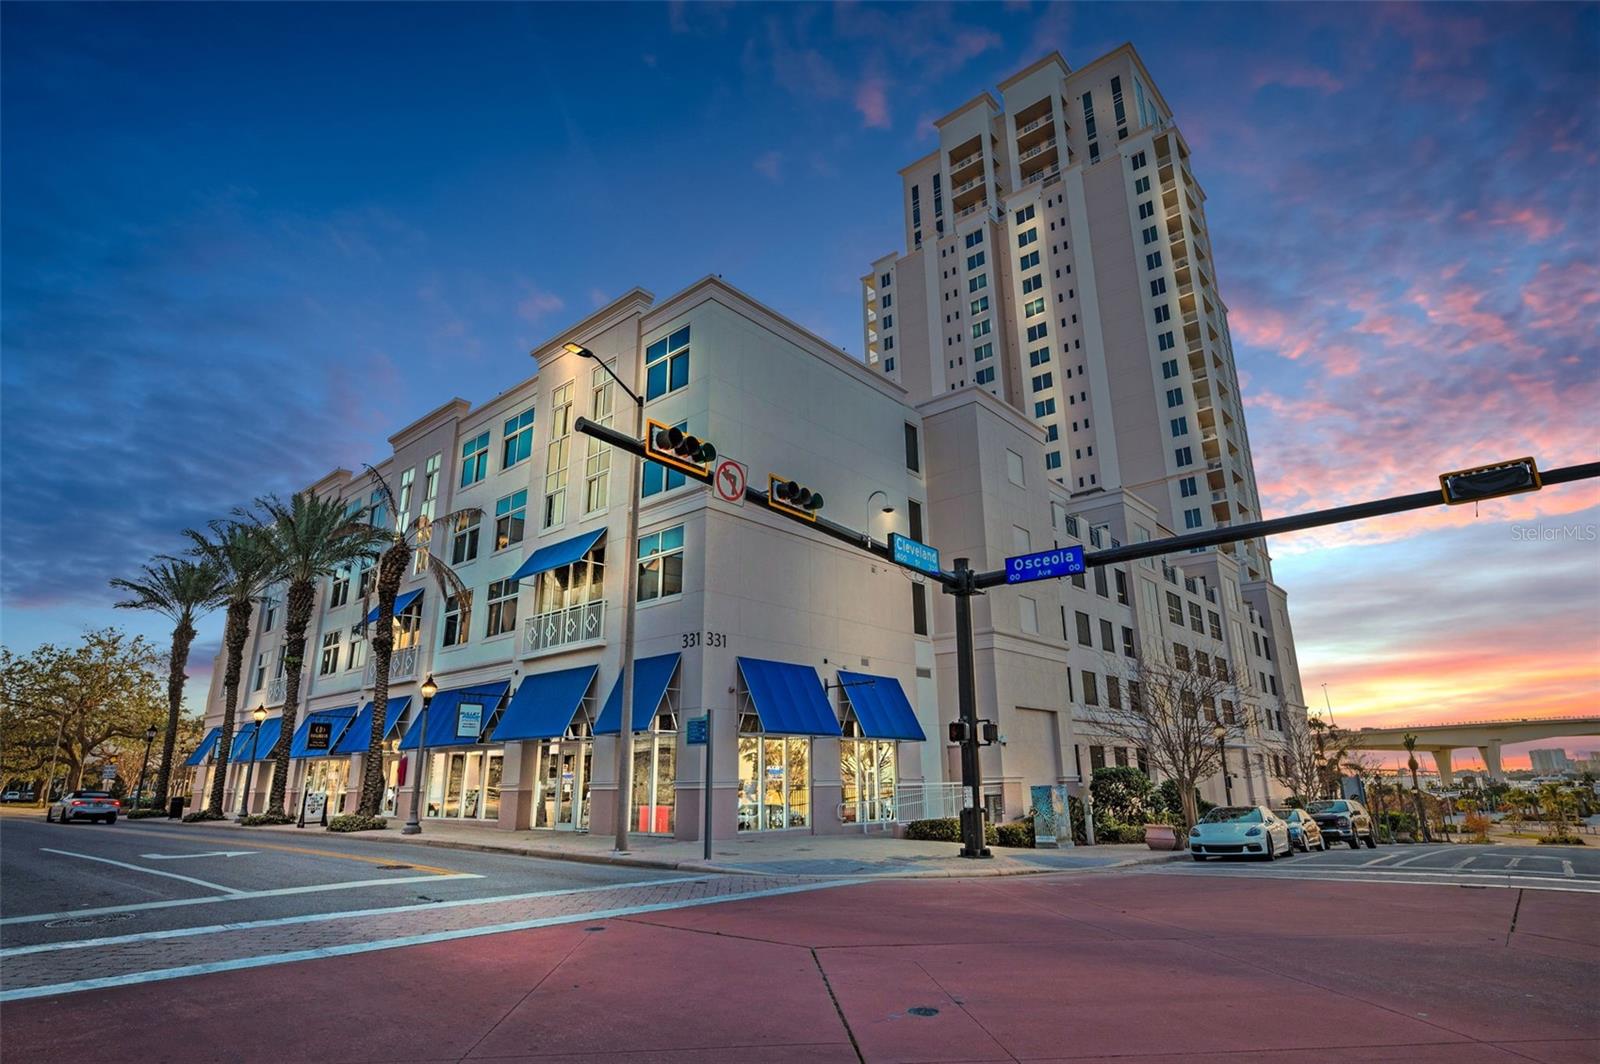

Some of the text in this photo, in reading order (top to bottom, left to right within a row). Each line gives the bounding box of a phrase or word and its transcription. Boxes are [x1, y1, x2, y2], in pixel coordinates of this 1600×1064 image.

[896, 537, 937, 564] Cleveland
[1014, 551, 1074, 571] Osceola
[1009, 563, 1081, 581] 00 Ave 00
[681, 631, 700, 649] 331
[706, 631, 727, 648] 331
